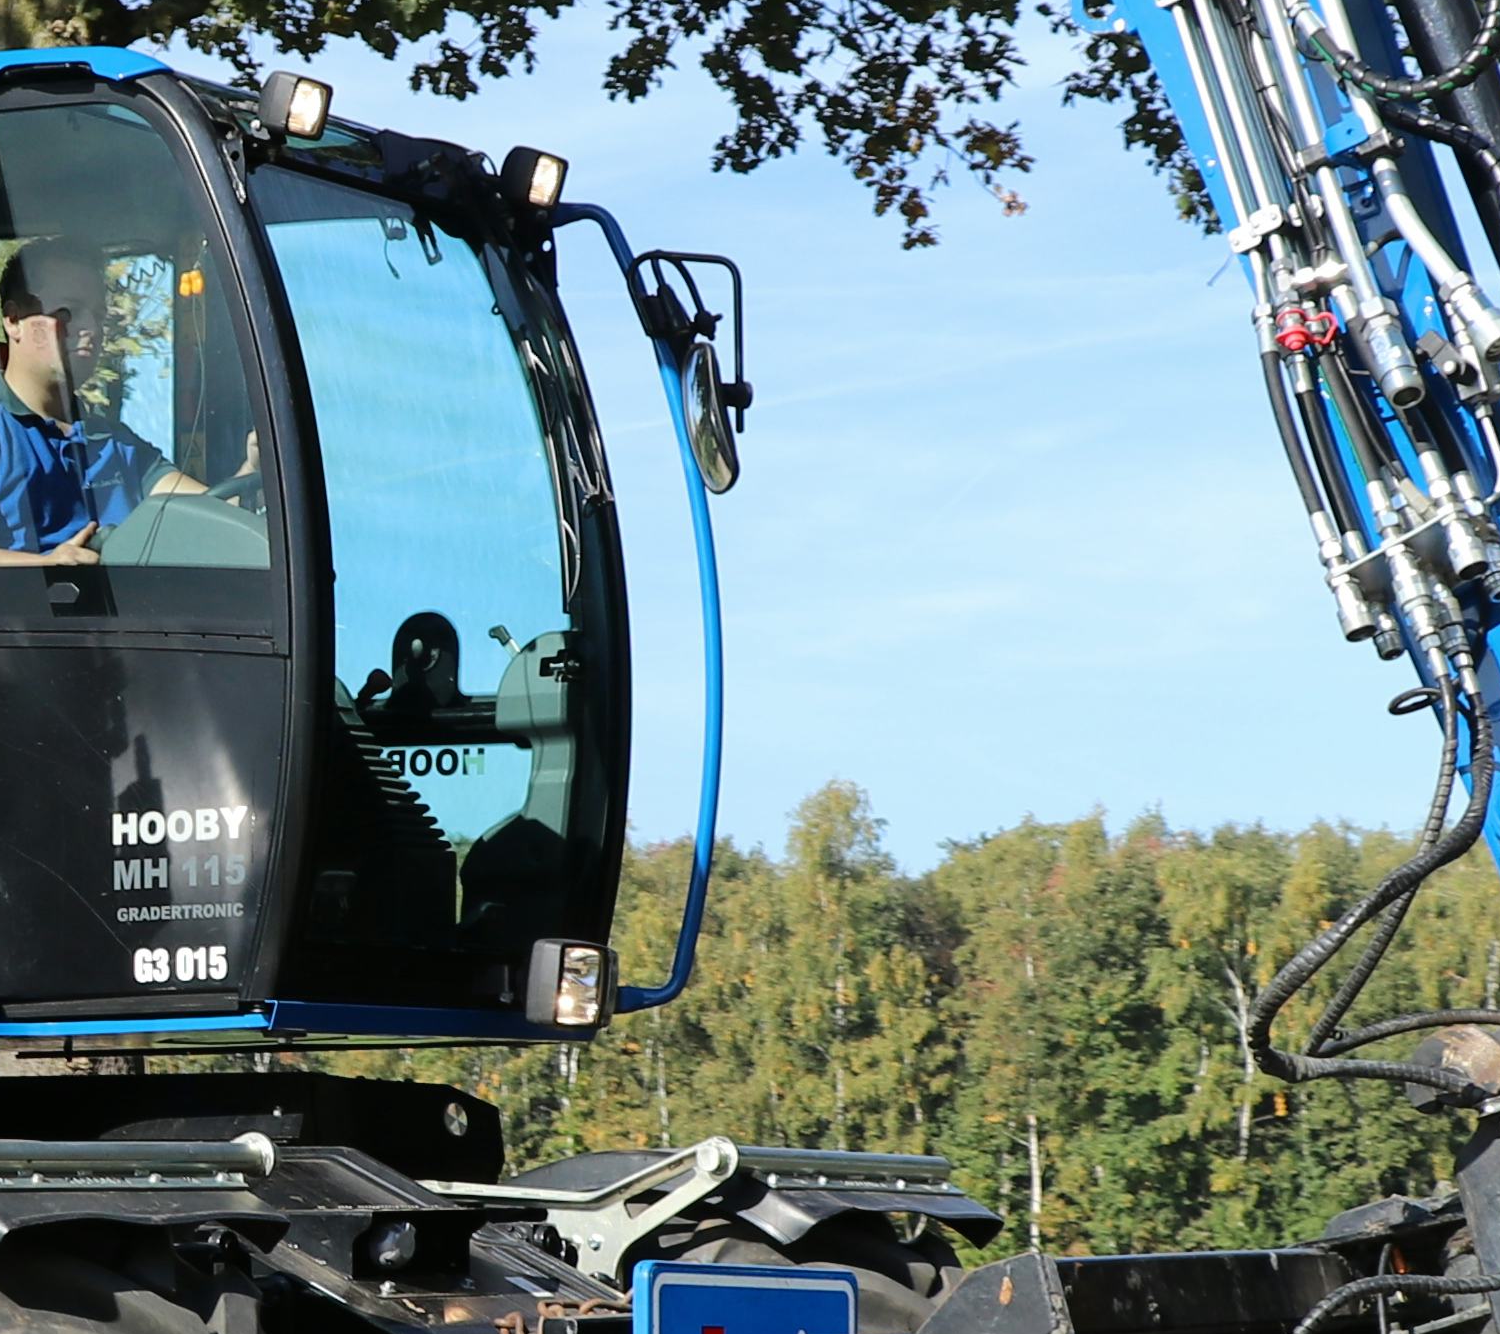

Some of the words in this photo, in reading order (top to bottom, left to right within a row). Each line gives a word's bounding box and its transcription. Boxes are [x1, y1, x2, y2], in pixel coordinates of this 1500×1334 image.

[112, 805, 248, 846] HOOBY
[113, 857, 168, 891] MH
[182, 854, 246, 887] 115
[117, 903, 244, 922] GRADERTRONIC
[133, 948, 171, 983] G3
[175, 946, 228, 981] 015
